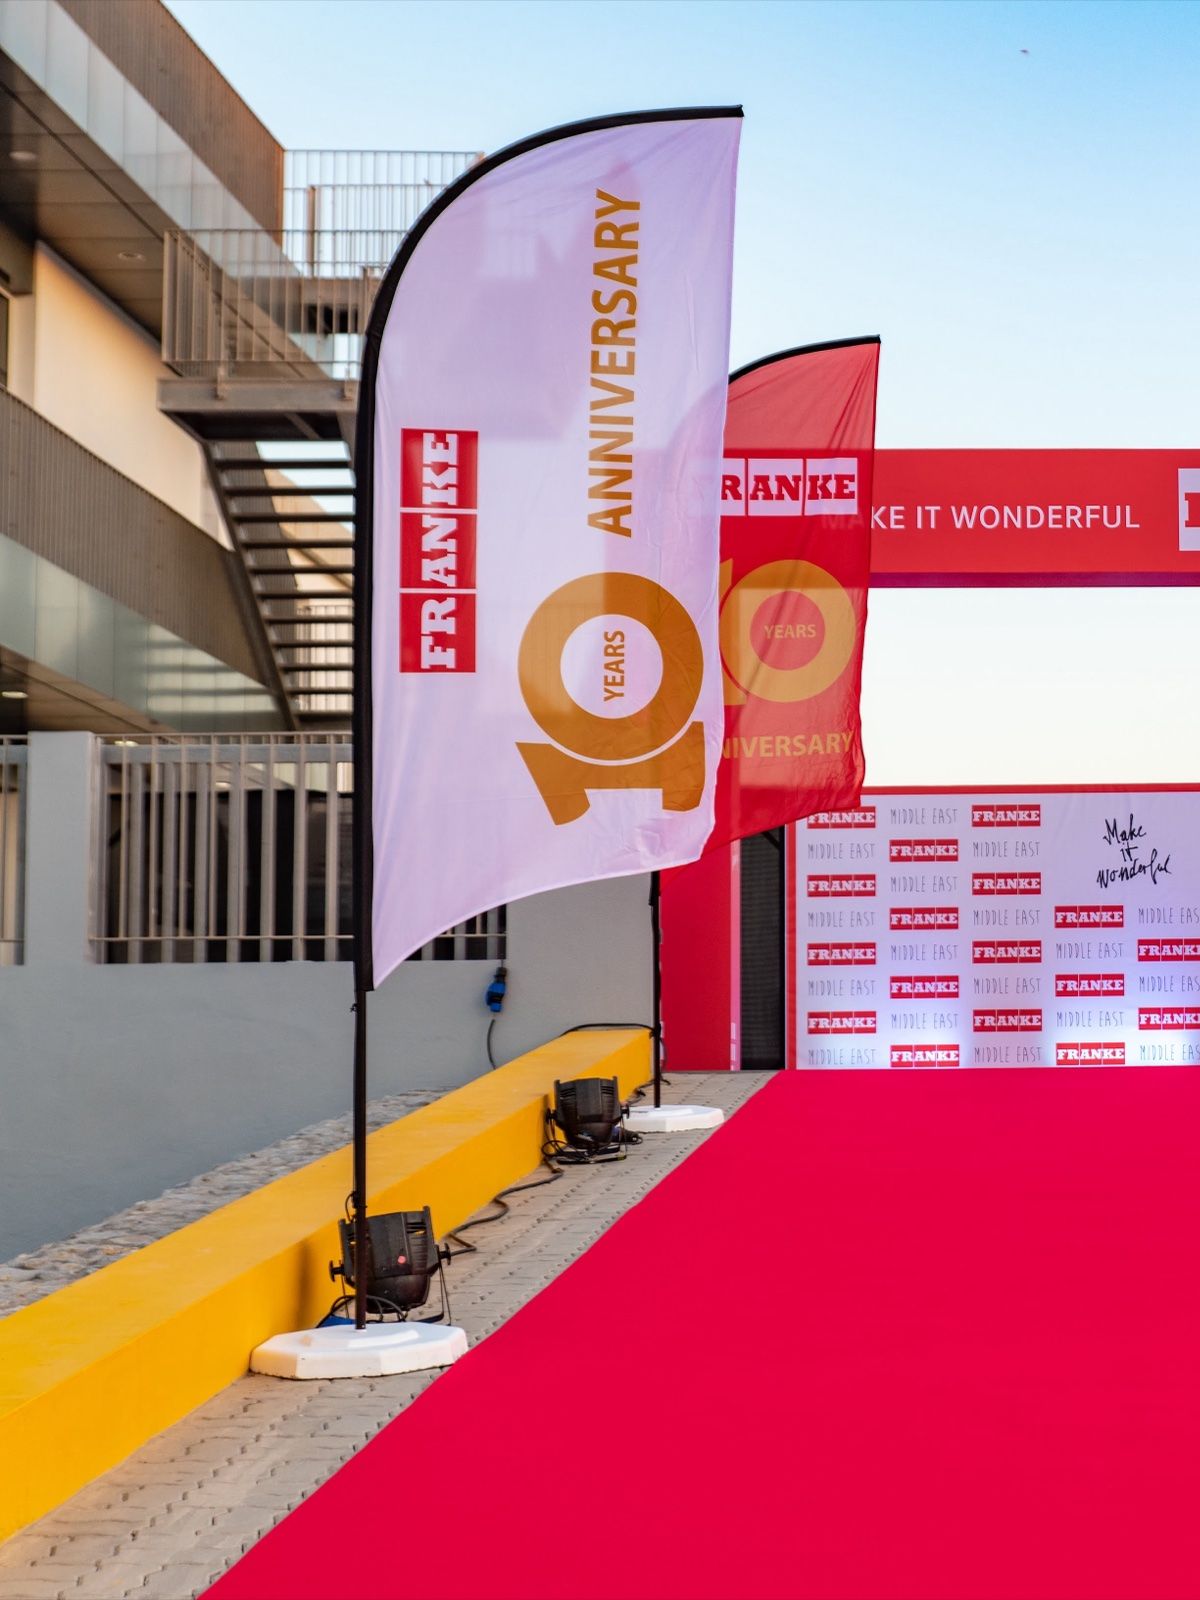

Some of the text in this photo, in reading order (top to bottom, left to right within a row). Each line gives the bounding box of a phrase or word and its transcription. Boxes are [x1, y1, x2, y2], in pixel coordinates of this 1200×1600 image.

[588, 187, 641, 538] ANNIVERSARY
[720, 474, 856, 501] RANKE
[916, 505, 941, 529] IT
[951, 505, 1140, 529] WONDERFUL
[421, 432, 459, 669] FRANKE
[763, 623, 817, 640] YEARS
[603, 630, 625, 702] YEARS
[891, 808, 958, 825] MIDDLE EAST
[972, 811, 1040, 823] FRANKE
[1103, 813, 1147, 845] Make
[808, 843, 875, 860] MIDDLE EAST
[890, 845, 958, 857] FRANKE
[973, 841, 1040, 858] MIDDLE EAST
[1120, 841, 1139, 862] it
[808, 880, 876, 892] FRANKE
[891, 876, 958, 893] MIDDLE EAST
[973, 878, 1040, 891] FRANKE
[808, 911, 875, 928] MIDDLE EAST
[890, 913, 958, 925] FRANKE
[973, 909, 1040, 926] MIDDLE EAST
[1055, 911, 1123, 924] FRANKE
[1138, 908, 1173, 925] MIDDLE
[808, 948, 876, 961] FRANKE
[891, 944, 958, 961] MIDDLE EAST
[973, 946, 1041, 959] FRANKE
[1056, 942, 1123, 960] MIDDLE EAST
[808, 979, 875, 997] MIDDLE EAST
[891, 982, 958, 994] FRANKE
[974, 977, 1041, 995] MIDDLE EAST
[1056, 980, 1124, 992] FRANKE
[1139, 976, 1174, 993] MIDDLE
[808, 1017, 876, 1029] FRANKE
[891, 1012, 958, 1030] MIDDLE EAST
[973, 1015, 1041, 1027] FRANKE
[1057, 1010, 1124, 1028] MIDDLE EAST
[808, 1048, 875, 1065] MIDDLE EAST
[891, 1050, 959, 1062] FRANKE
[974, 1046, 1041, 1063] MIDDLE EAST
[1056, 1048, 1124, 1060] FRANKE
[1139, 1044, 1174, 1061] MIDDLE
